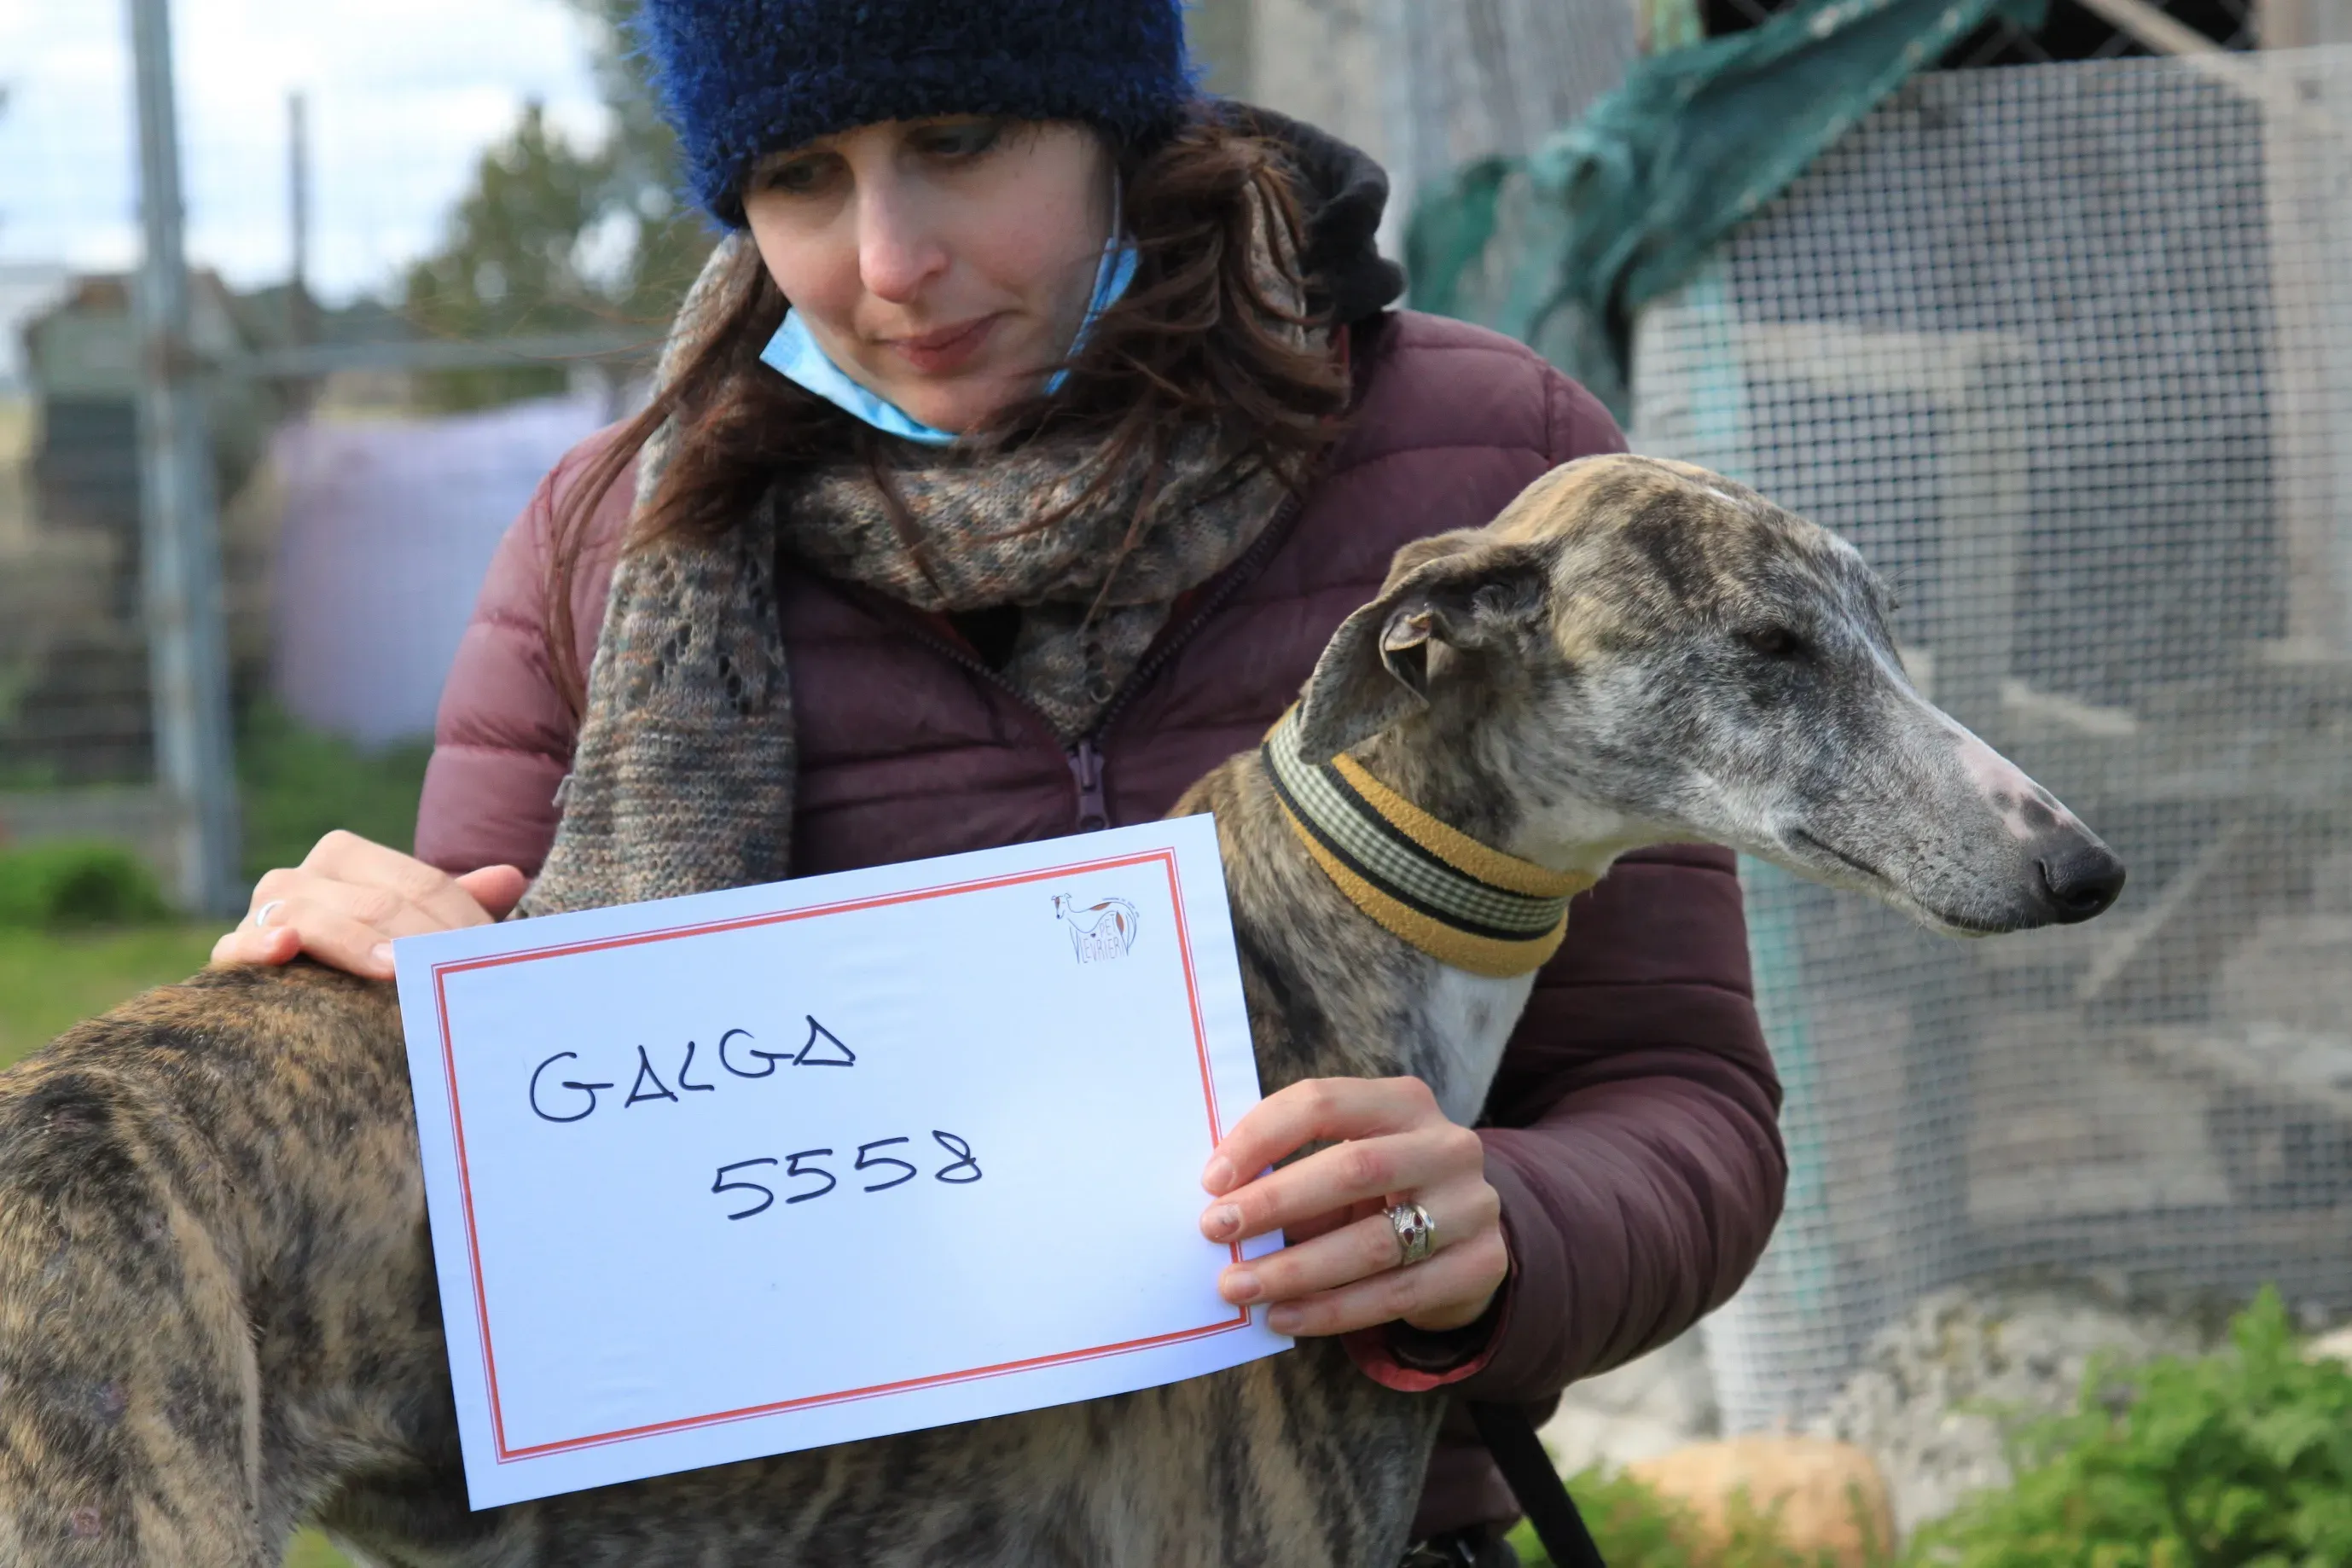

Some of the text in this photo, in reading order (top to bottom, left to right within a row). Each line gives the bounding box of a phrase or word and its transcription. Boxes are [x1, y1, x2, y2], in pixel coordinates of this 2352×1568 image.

[1099, 914, 1116, 938] PET
[529, 1014, 856, 1123] GALGA
[711, 1130, 983, 1220] 5558
